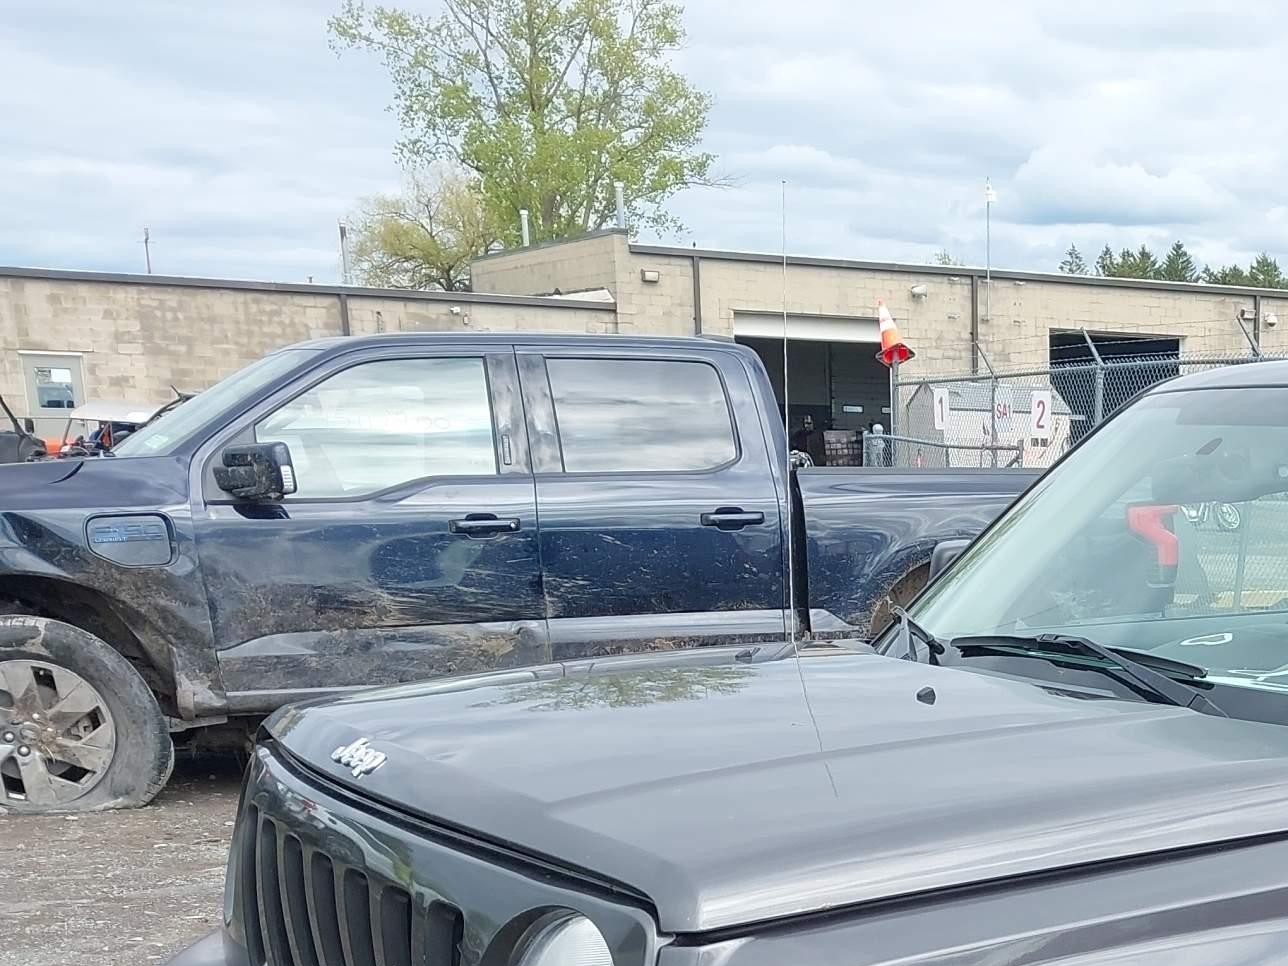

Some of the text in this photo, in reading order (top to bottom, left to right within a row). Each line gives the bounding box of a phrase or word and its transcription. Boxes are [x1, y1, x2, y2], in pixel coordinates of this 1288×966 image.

[937, 395, 945, 424] 1
[1036, 399, 1046, 429] 2
[331, 737, 387, 779] Jeep
